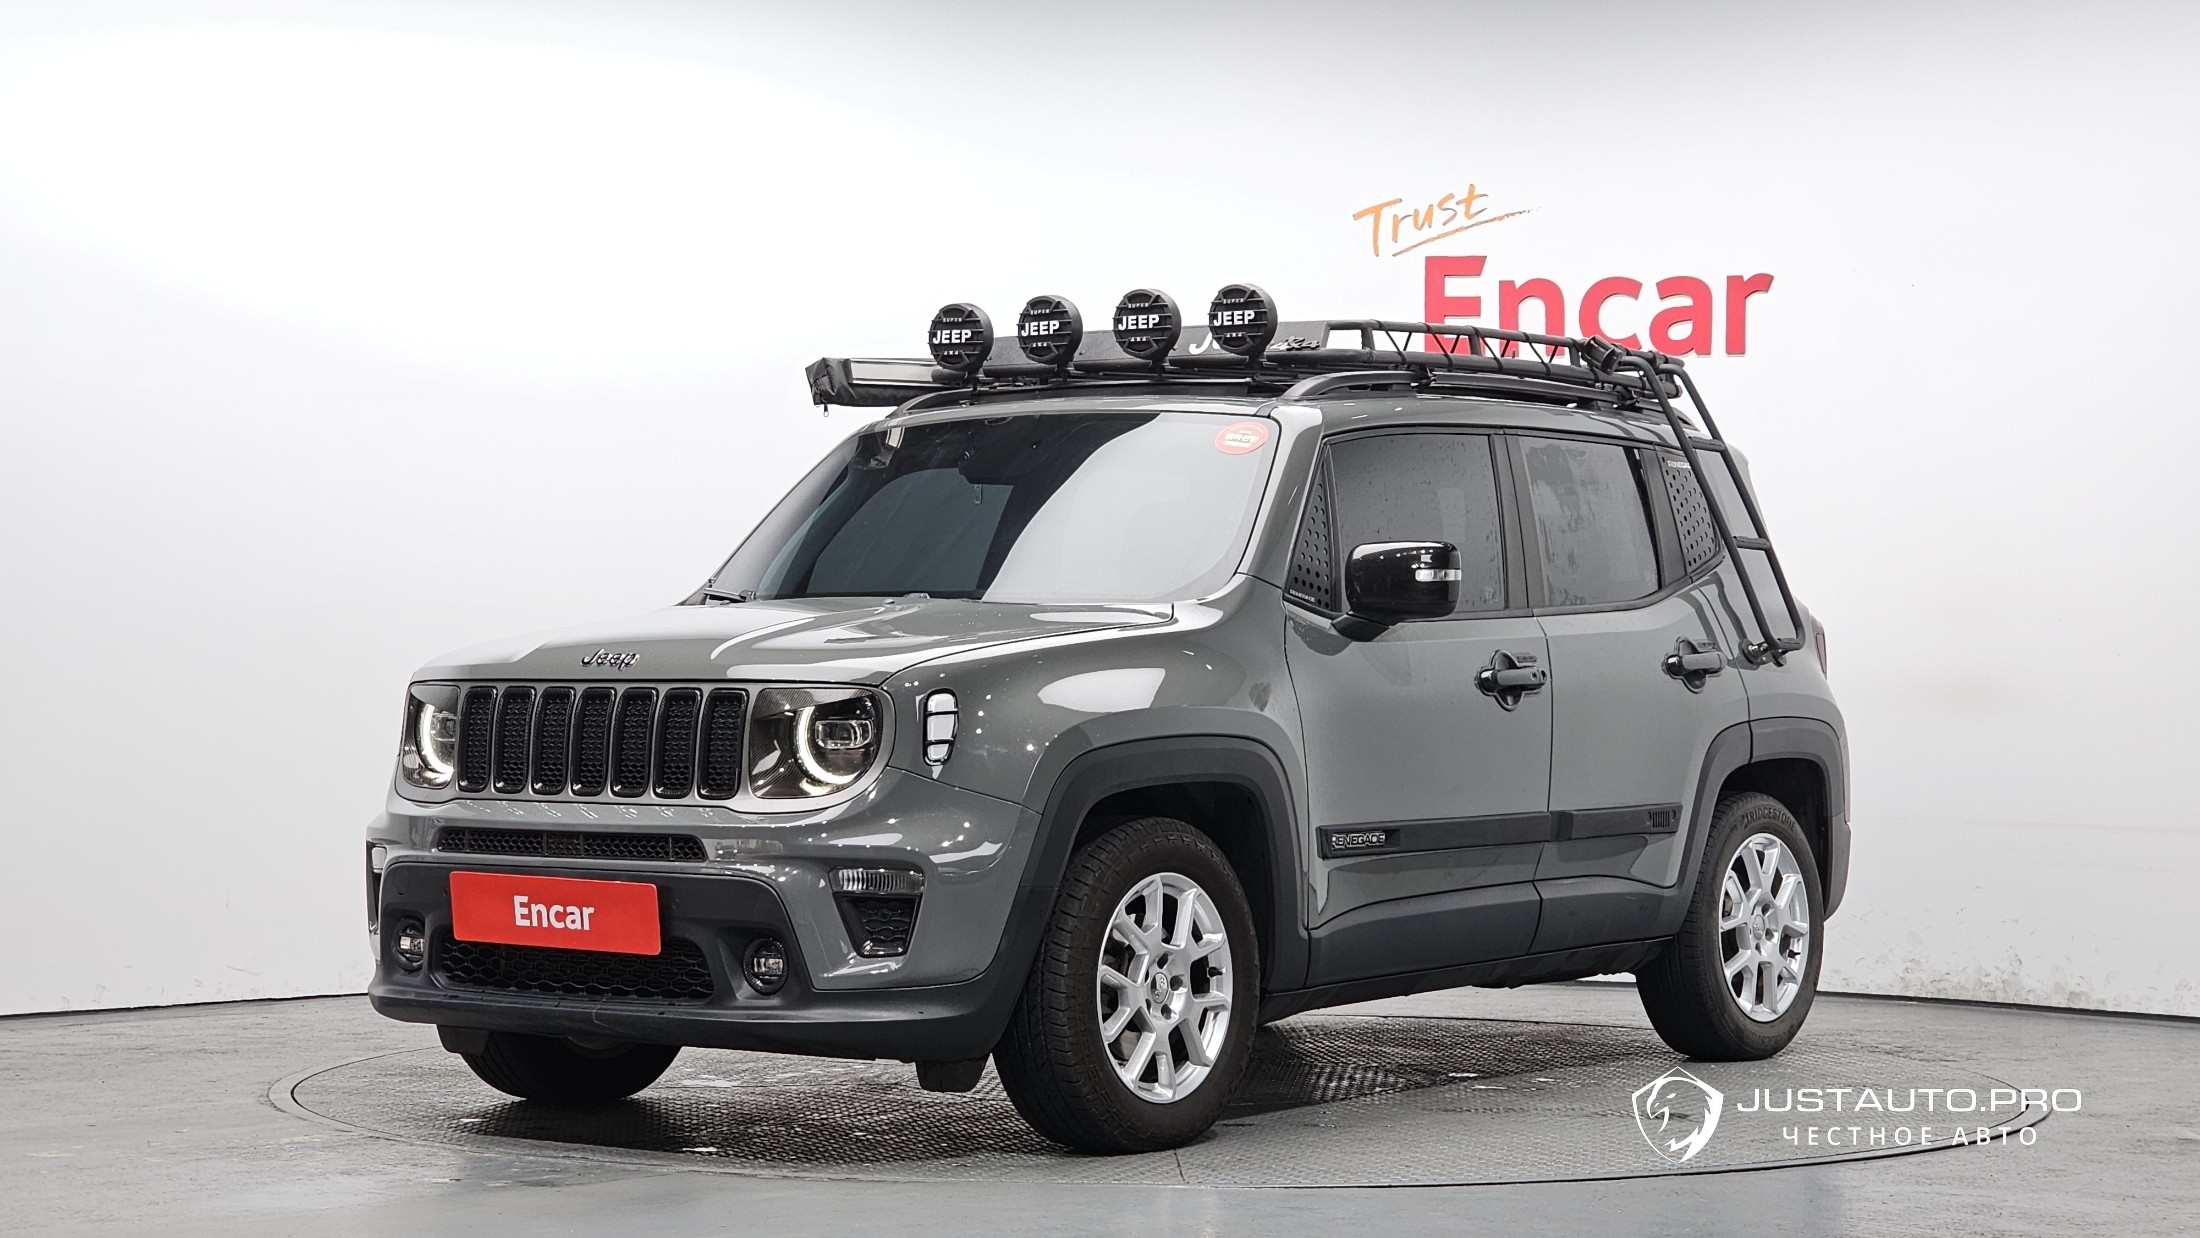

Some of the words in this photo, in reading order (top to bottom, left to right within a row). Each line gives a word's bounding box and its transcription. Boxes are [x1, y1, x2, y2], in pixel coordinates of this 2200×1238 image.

[1352, 183, 1489, 257] Trust
[1424, 255, 1775, 357] Encar
[1021, 320, 1060, 337] JEEP
[1117, 314, 1160, 331] JEEP
[1213, 310, 1256, 327] JEEP
[932, 329, 972, 344] JEEP
[580, 648, 640, 672] Jeep
[1742, 806, 1797, 831] BRIDGESTONE
[1331, 831, 1386, 851] RENEGADE
[513, 895, 594, 932] Encar
